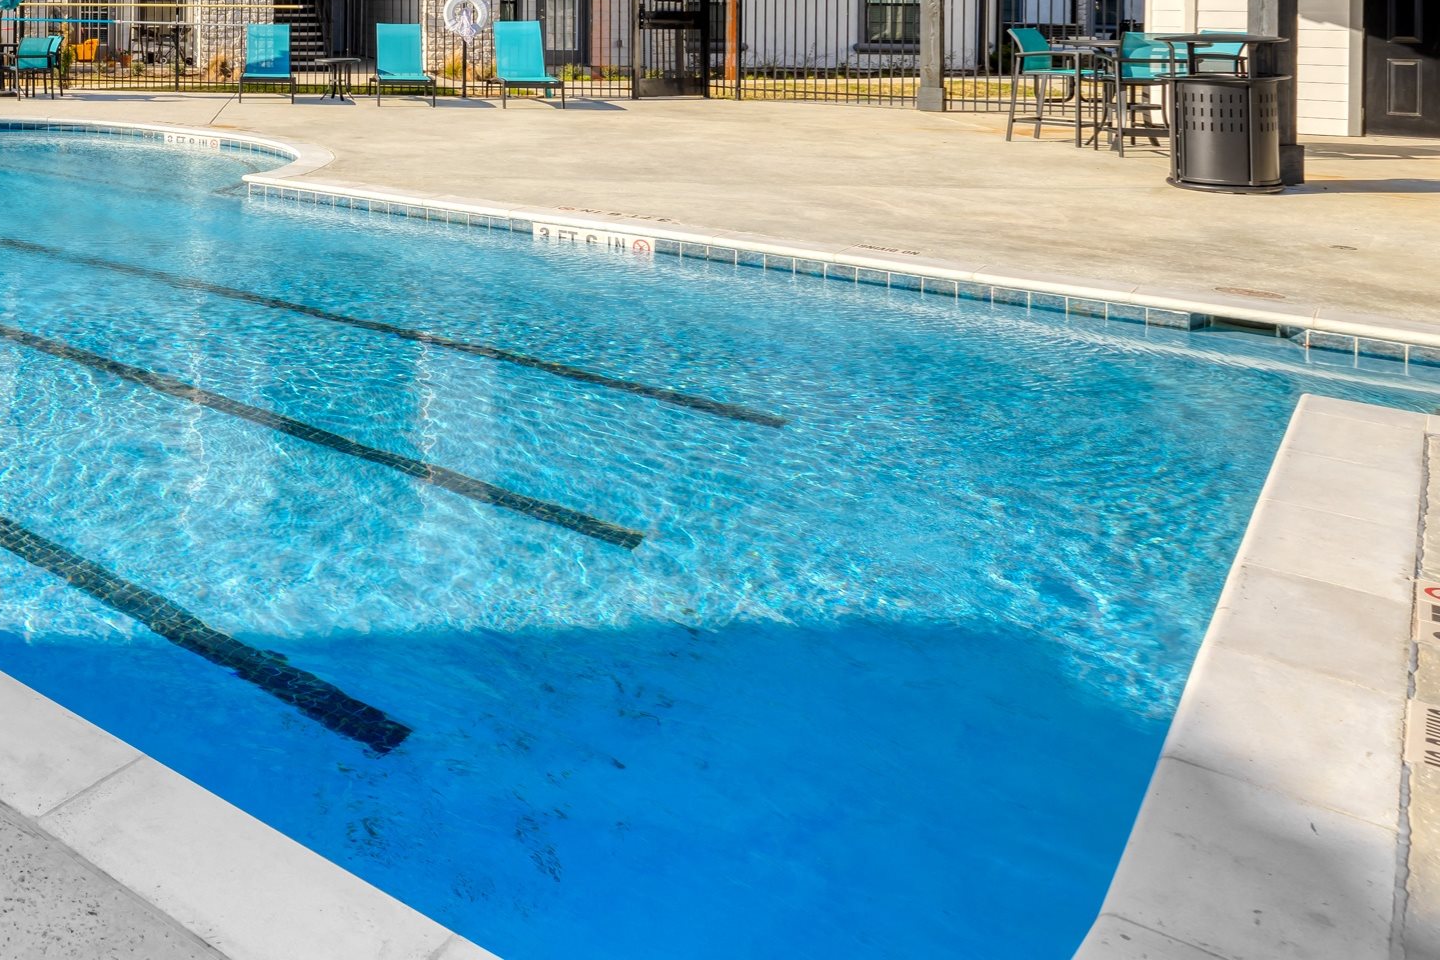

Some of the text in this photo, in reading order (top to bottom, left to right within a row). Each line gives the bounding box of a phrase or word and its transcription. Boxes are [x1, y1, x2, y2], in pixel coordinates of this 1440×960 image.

[539, 227, 550, 238] 3
[558, 229, 578, 241] FT
[607, 236, 626, 249] IN
